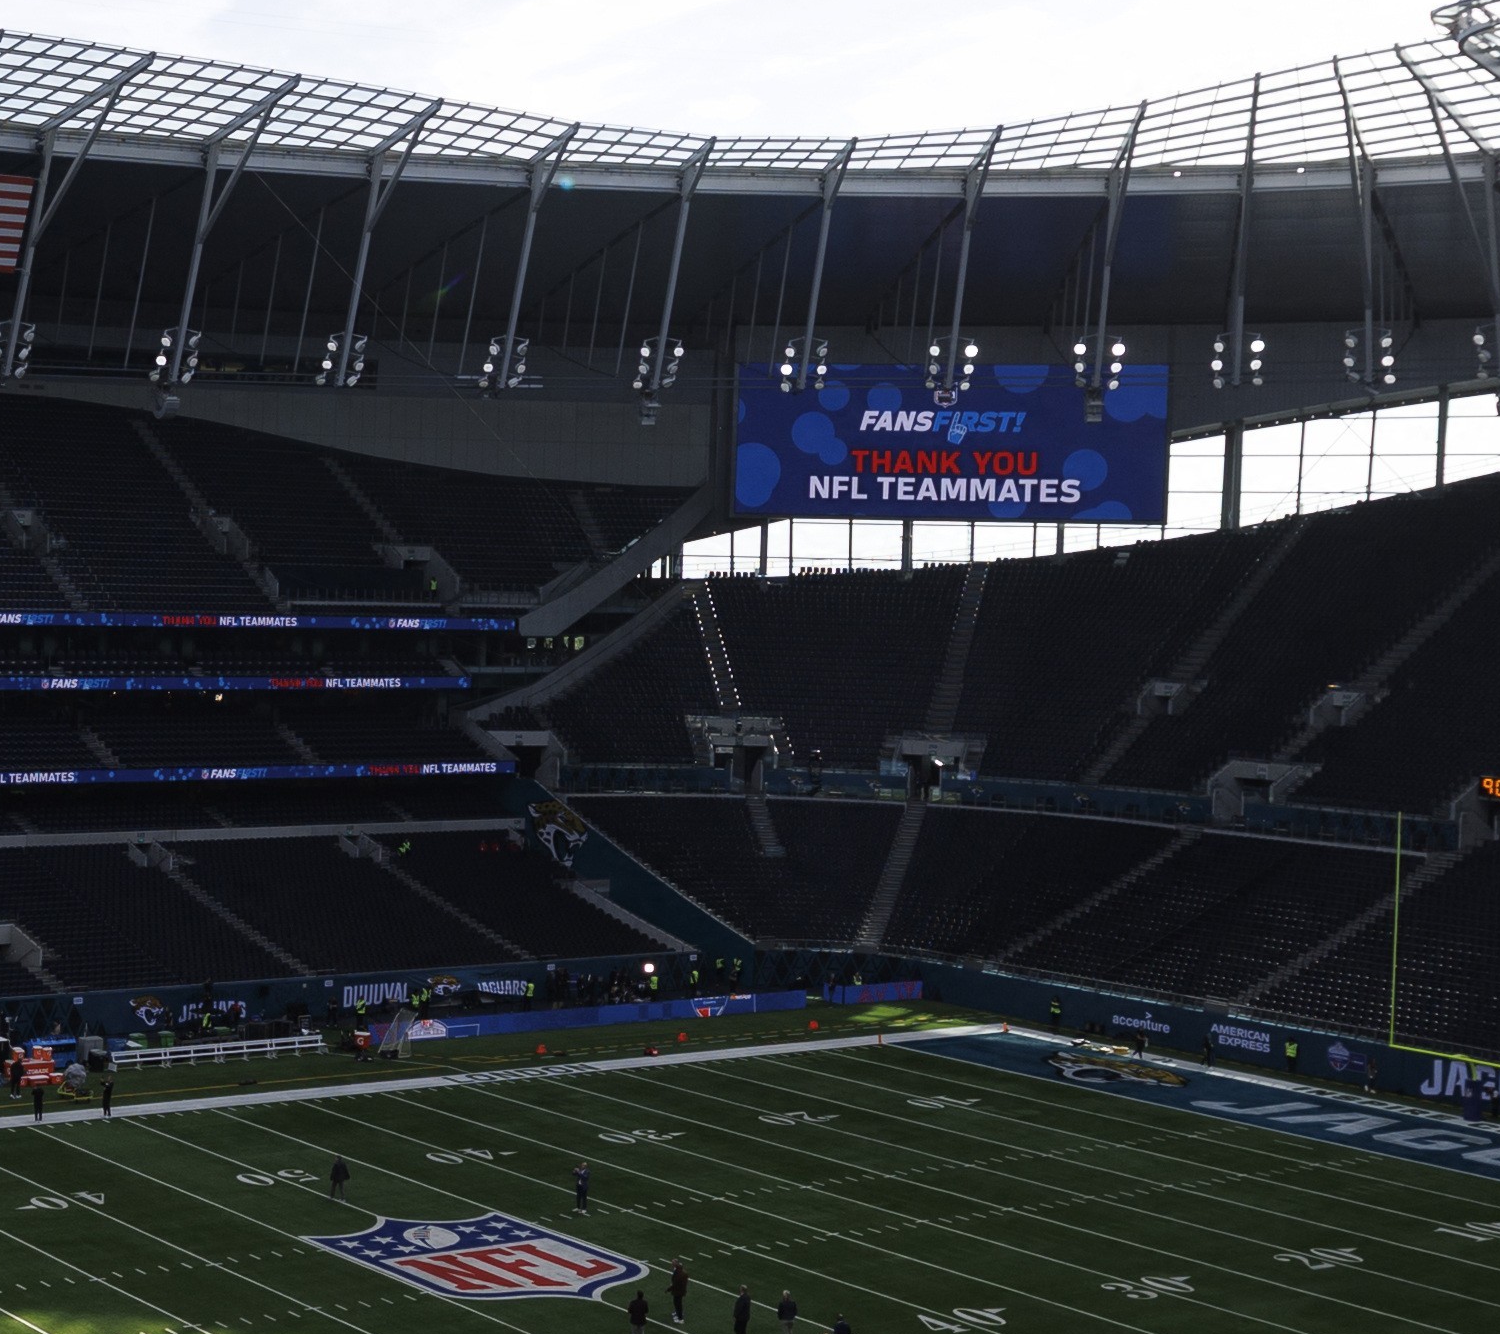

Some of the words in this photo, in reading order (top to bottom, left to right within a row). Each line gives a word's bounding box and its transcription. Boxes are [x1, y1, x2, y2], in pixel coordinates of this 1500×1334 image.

[851, 449, 961, 475] THANK
[973, 451, 1039, 476] YOU
[809, 475, 868, 500] NFL
[877, 476, 1081, 504] TEAMMATES
[1112, 1014, 1171, 1034] accenture
[1211, 1023, 1270, 1043] AMERICAN
[356, 1036, 365, 1046] G
[1218, 1035, 1271, 1053] EXPRESS
[442, 1062, 600, 1084] LONDON
[1290, 1086, 1461, 1122] INSPIRE
[598, 1127, 674, 1146] 30
[425, 1146, 496, 1165] 40
[235, 1167, 320, 1187] 50
[25, 1189, 106, 1212] 40
[401, 1241, 624, 1291] NFL
[1273, 1247, 1365, 1271] 20
[1101, 1275, 1196, 1301] 30
[917, 1306, 1007, 1334] 40
